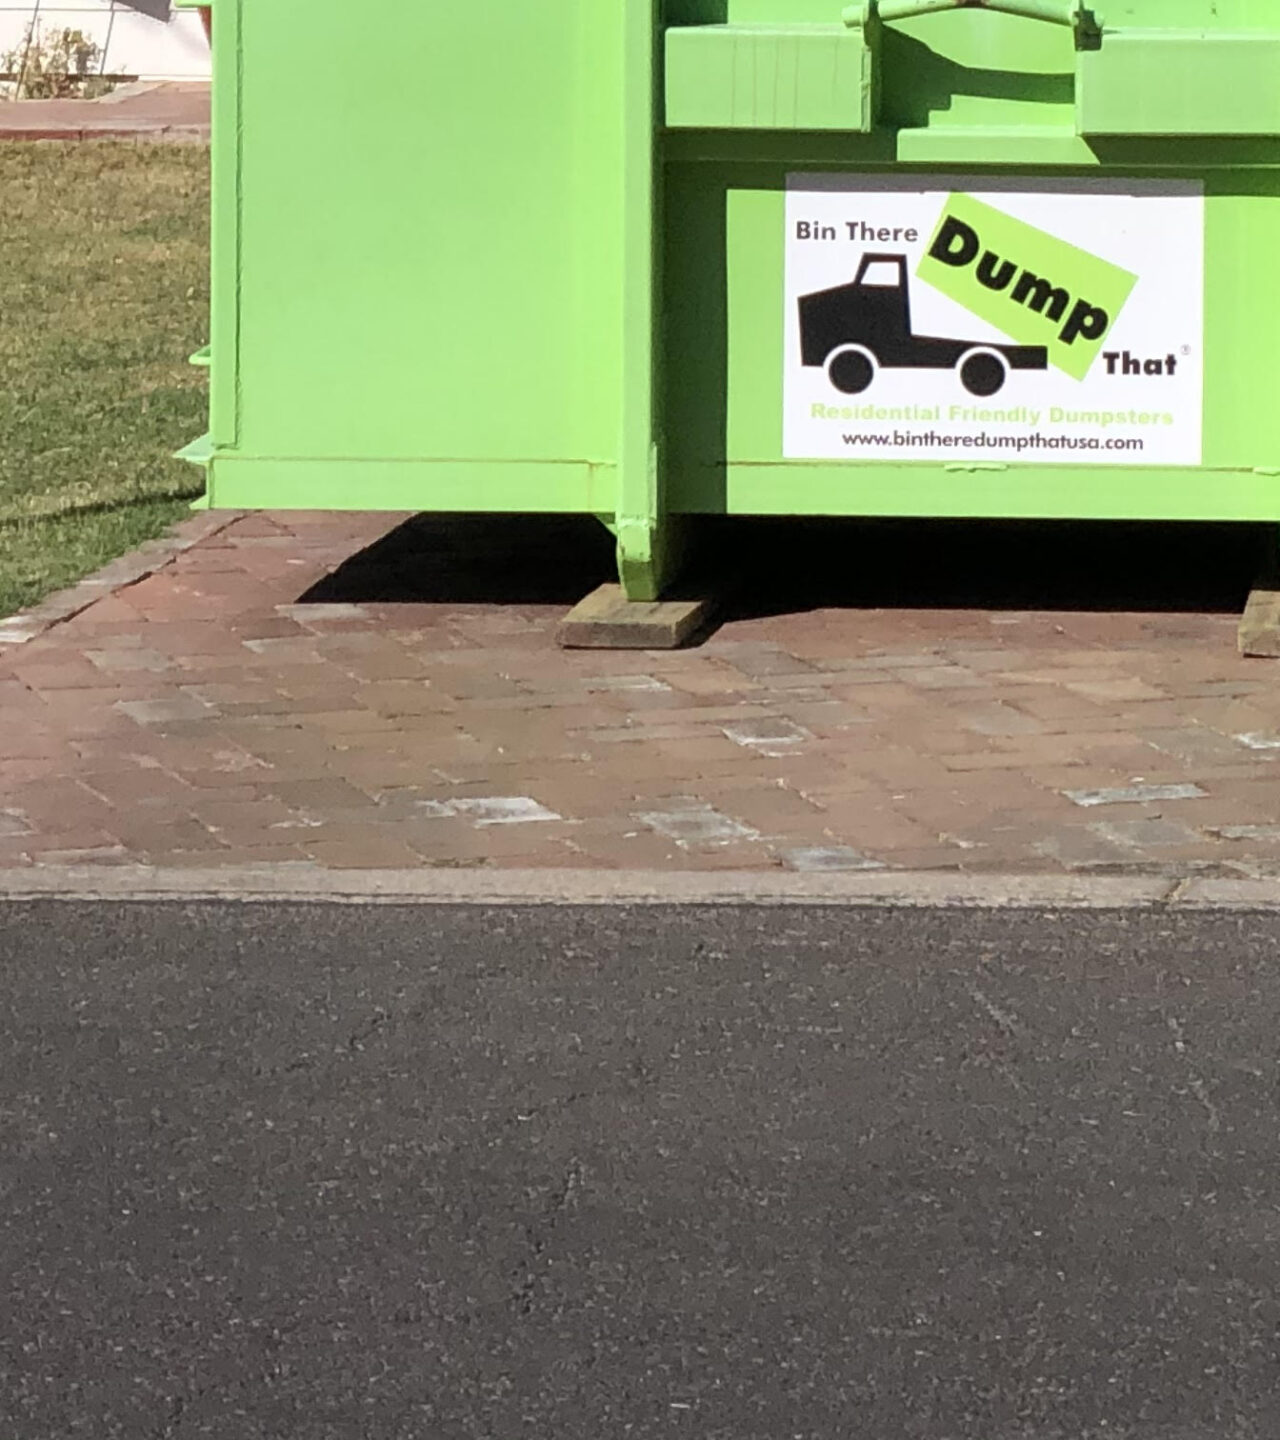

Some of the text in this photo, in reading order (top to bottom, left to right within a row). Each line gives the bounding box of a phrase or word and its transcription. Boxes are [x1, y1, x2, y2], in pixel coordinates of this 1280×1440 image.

[796, 221, 919, 243] Bin There
[927, 214, 1109, 346] Dump
[1102, 351, 1178, 376] That
[810, 403, 1174, 427] Residential Friendly Dumpsters
[842, 430, 1144, 452] www.bintheredumpthatusa.com
